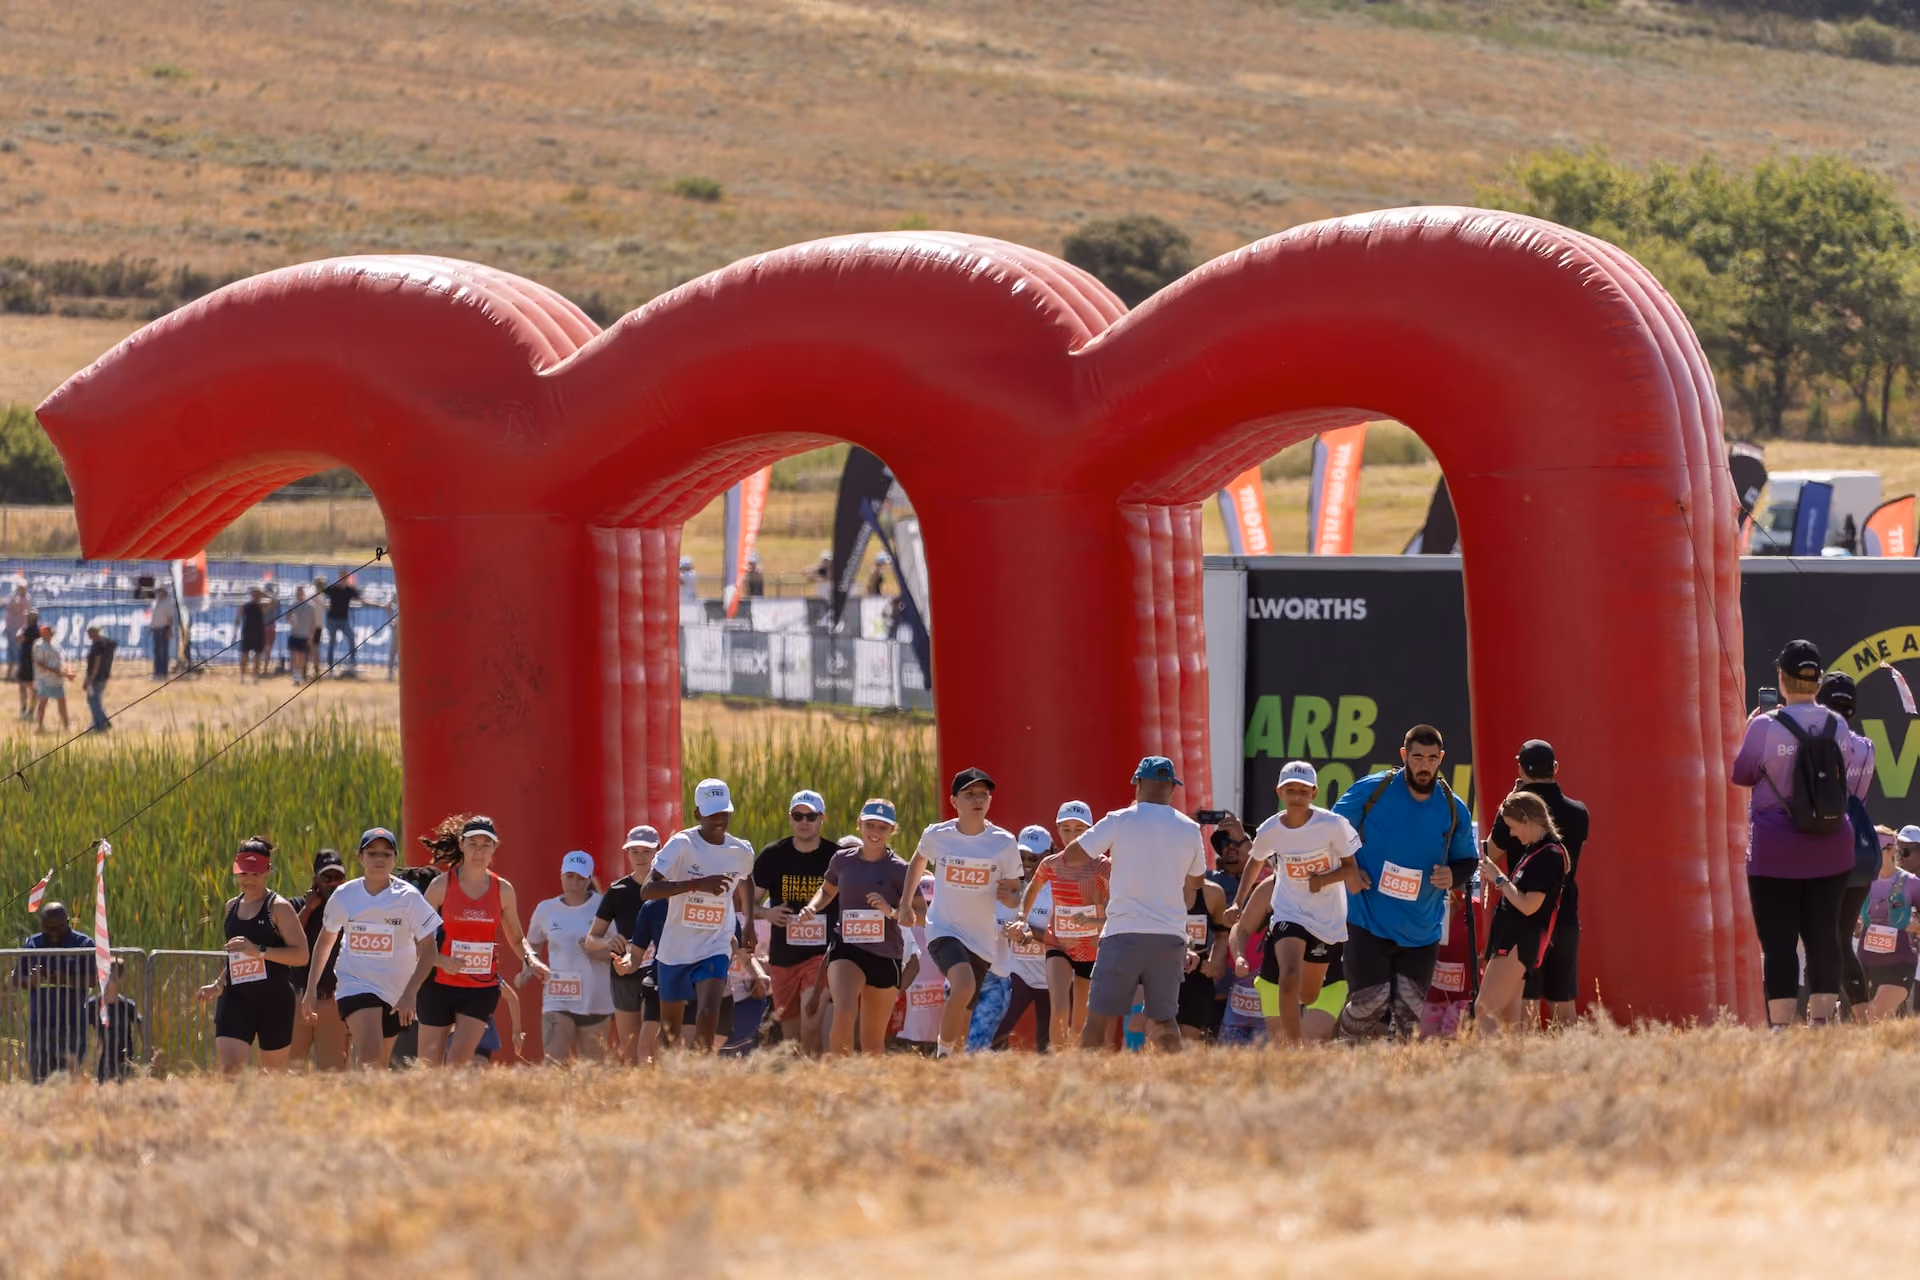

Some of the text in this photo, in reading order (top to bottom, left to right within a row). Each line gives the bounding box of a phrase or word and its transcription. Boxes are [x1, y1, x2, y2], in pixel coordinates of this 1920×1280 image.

[1238, 483, 1267, 555] mom
[1852, 639, 1892, 673] ME
[1245, 695, 1379, 760] ARB
[950, 868, 985, 883] 2142
[1383, 876, 1418, 893] 5689
[687, 908, 722, 922] 5693
[791, 926, 824, 938] 2104
[845, 923, 881, 936] 5648
[351, 934, 391, 949] 2069
[232, 960, 260, 977] 5727
[550, 983, 578, 994] 5748
